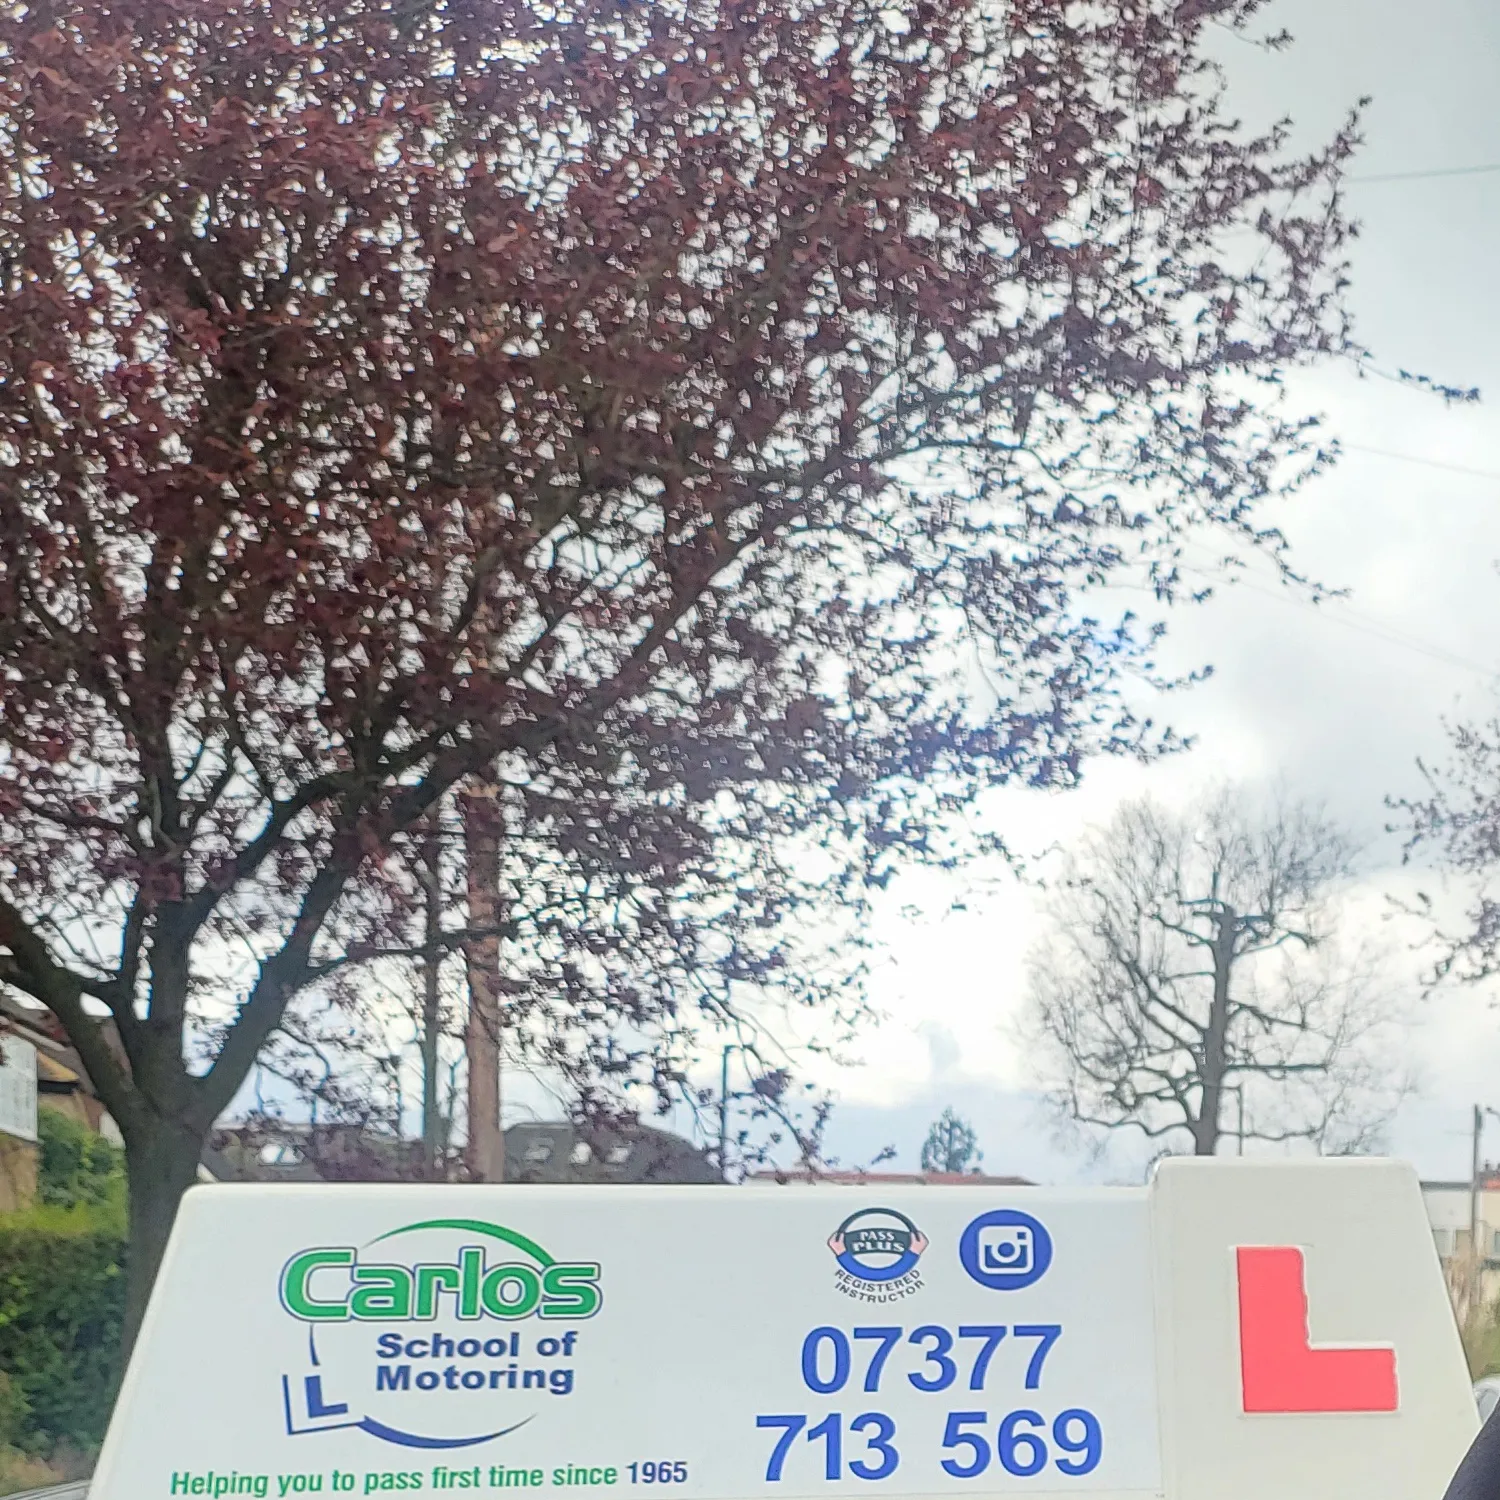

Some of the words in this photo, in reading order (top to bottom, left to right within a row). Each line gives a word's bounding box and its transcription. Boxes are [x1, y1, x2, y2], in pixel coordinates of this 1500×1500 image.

[851, 1240, 906, 1252] PLUS
[859, 1230, 895, 1241] PASS
[278, 1245, 603, 1321] Carlos
[834, 1268, 921, 1293] REGISTERED
[834, 1280, 926, 1304] INSTRUCTOR
[375, 1332, 521, 1359] School
[535, 1330, 579, 1358] of
[1236, 1245, 1399, 1413] L
[801, 1324, 1063, 1395] 07377
[375, 1364, 574, 1396] Motoring
[755, 1411, 900, 1483] 713
[940, 1407, 1102, 1479] 569
[170, 1469, 268, 1499] Helping
[277, 1473, 324, 1498] you
[331, 1468, 356, 1493] to
[364, 1471, 423, 1495] pass
[431, 1465, 484, 1490] first
[488, 1464, 544, 1489] time
[551, 1463, 618, 1487] since
[625, 1460, 688, 1486] 1965
